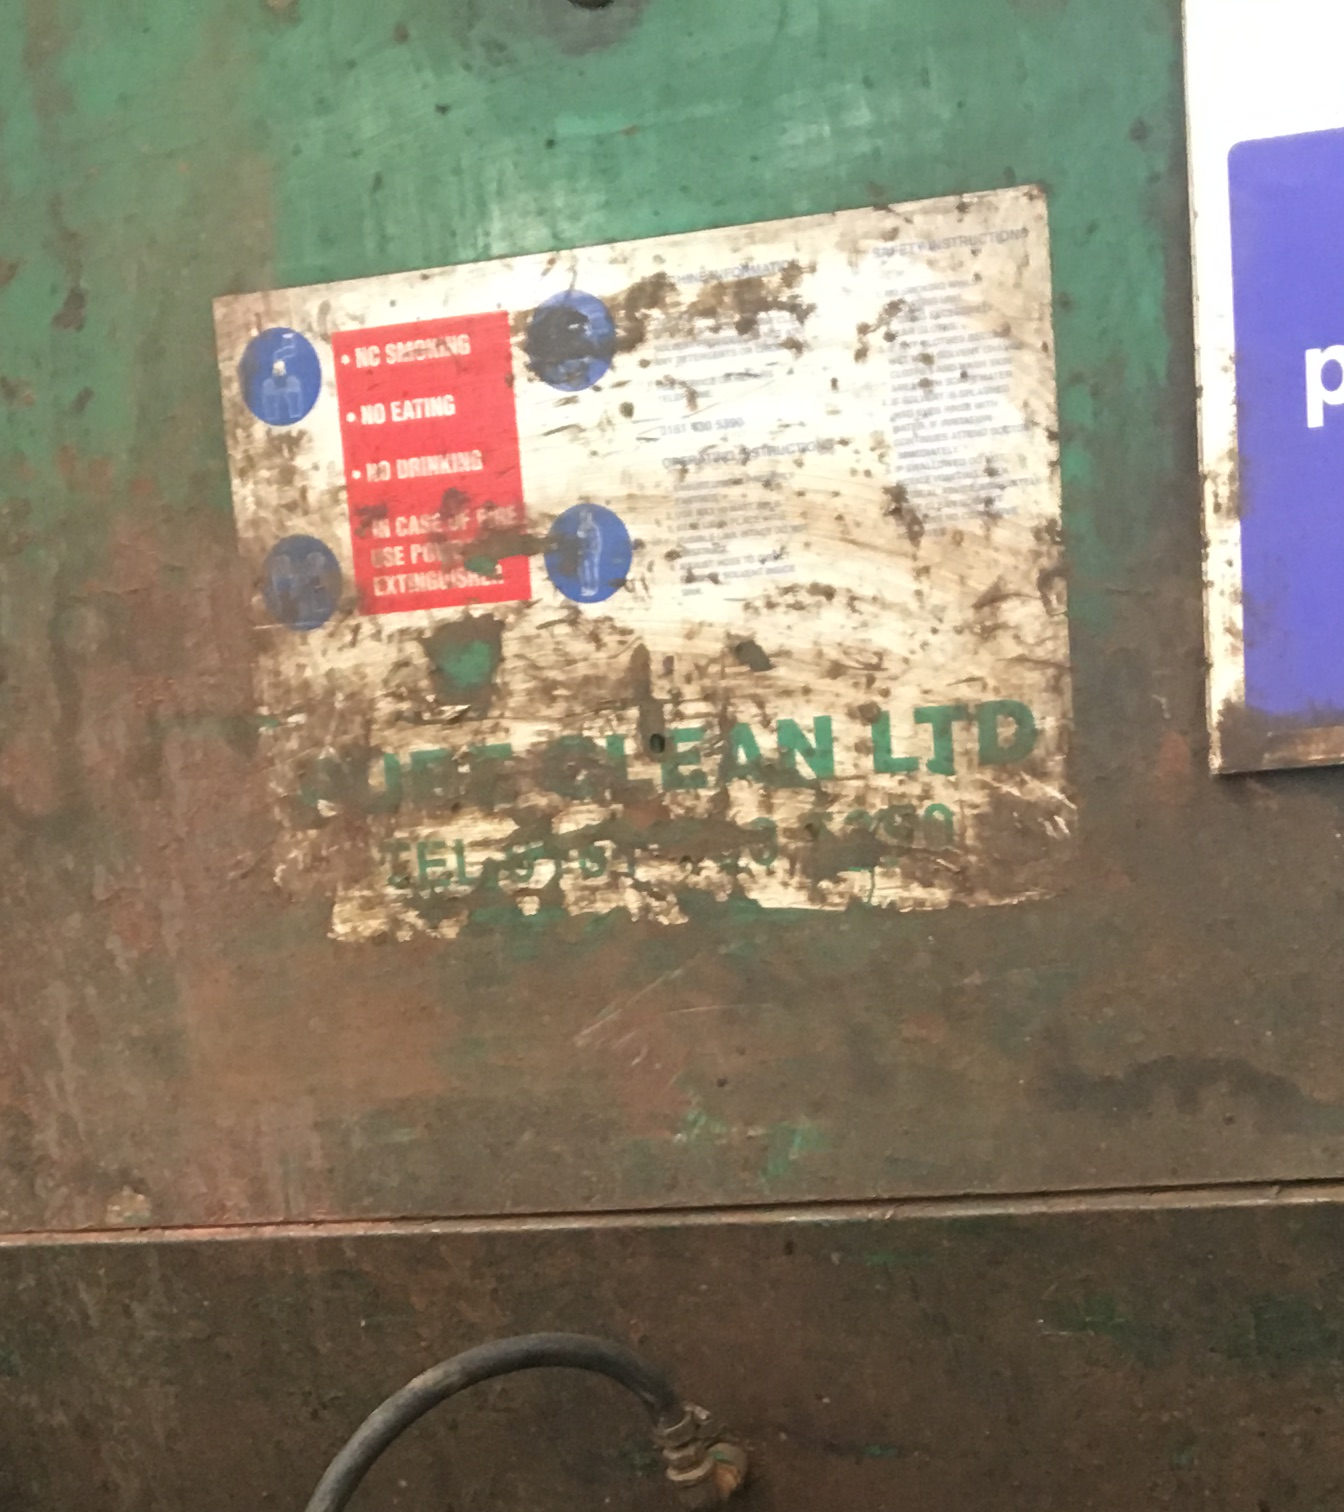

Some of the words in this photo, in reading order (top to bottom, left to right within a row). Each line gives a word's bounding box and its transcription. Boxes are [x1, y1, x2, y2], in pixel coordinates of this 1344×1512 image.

[385, 333, 471, 364] SMOKING
[360, 403, 386, 425] NO
[390, 394, 456, 422] EATING
[366, 460, 391, 482] NO
[396, 450, 483, 479] DRINKING
[396, 513, 443, 537] CASE
[371, 546, 405, 568] USE
[870, 699, 1038, 776] LTD
